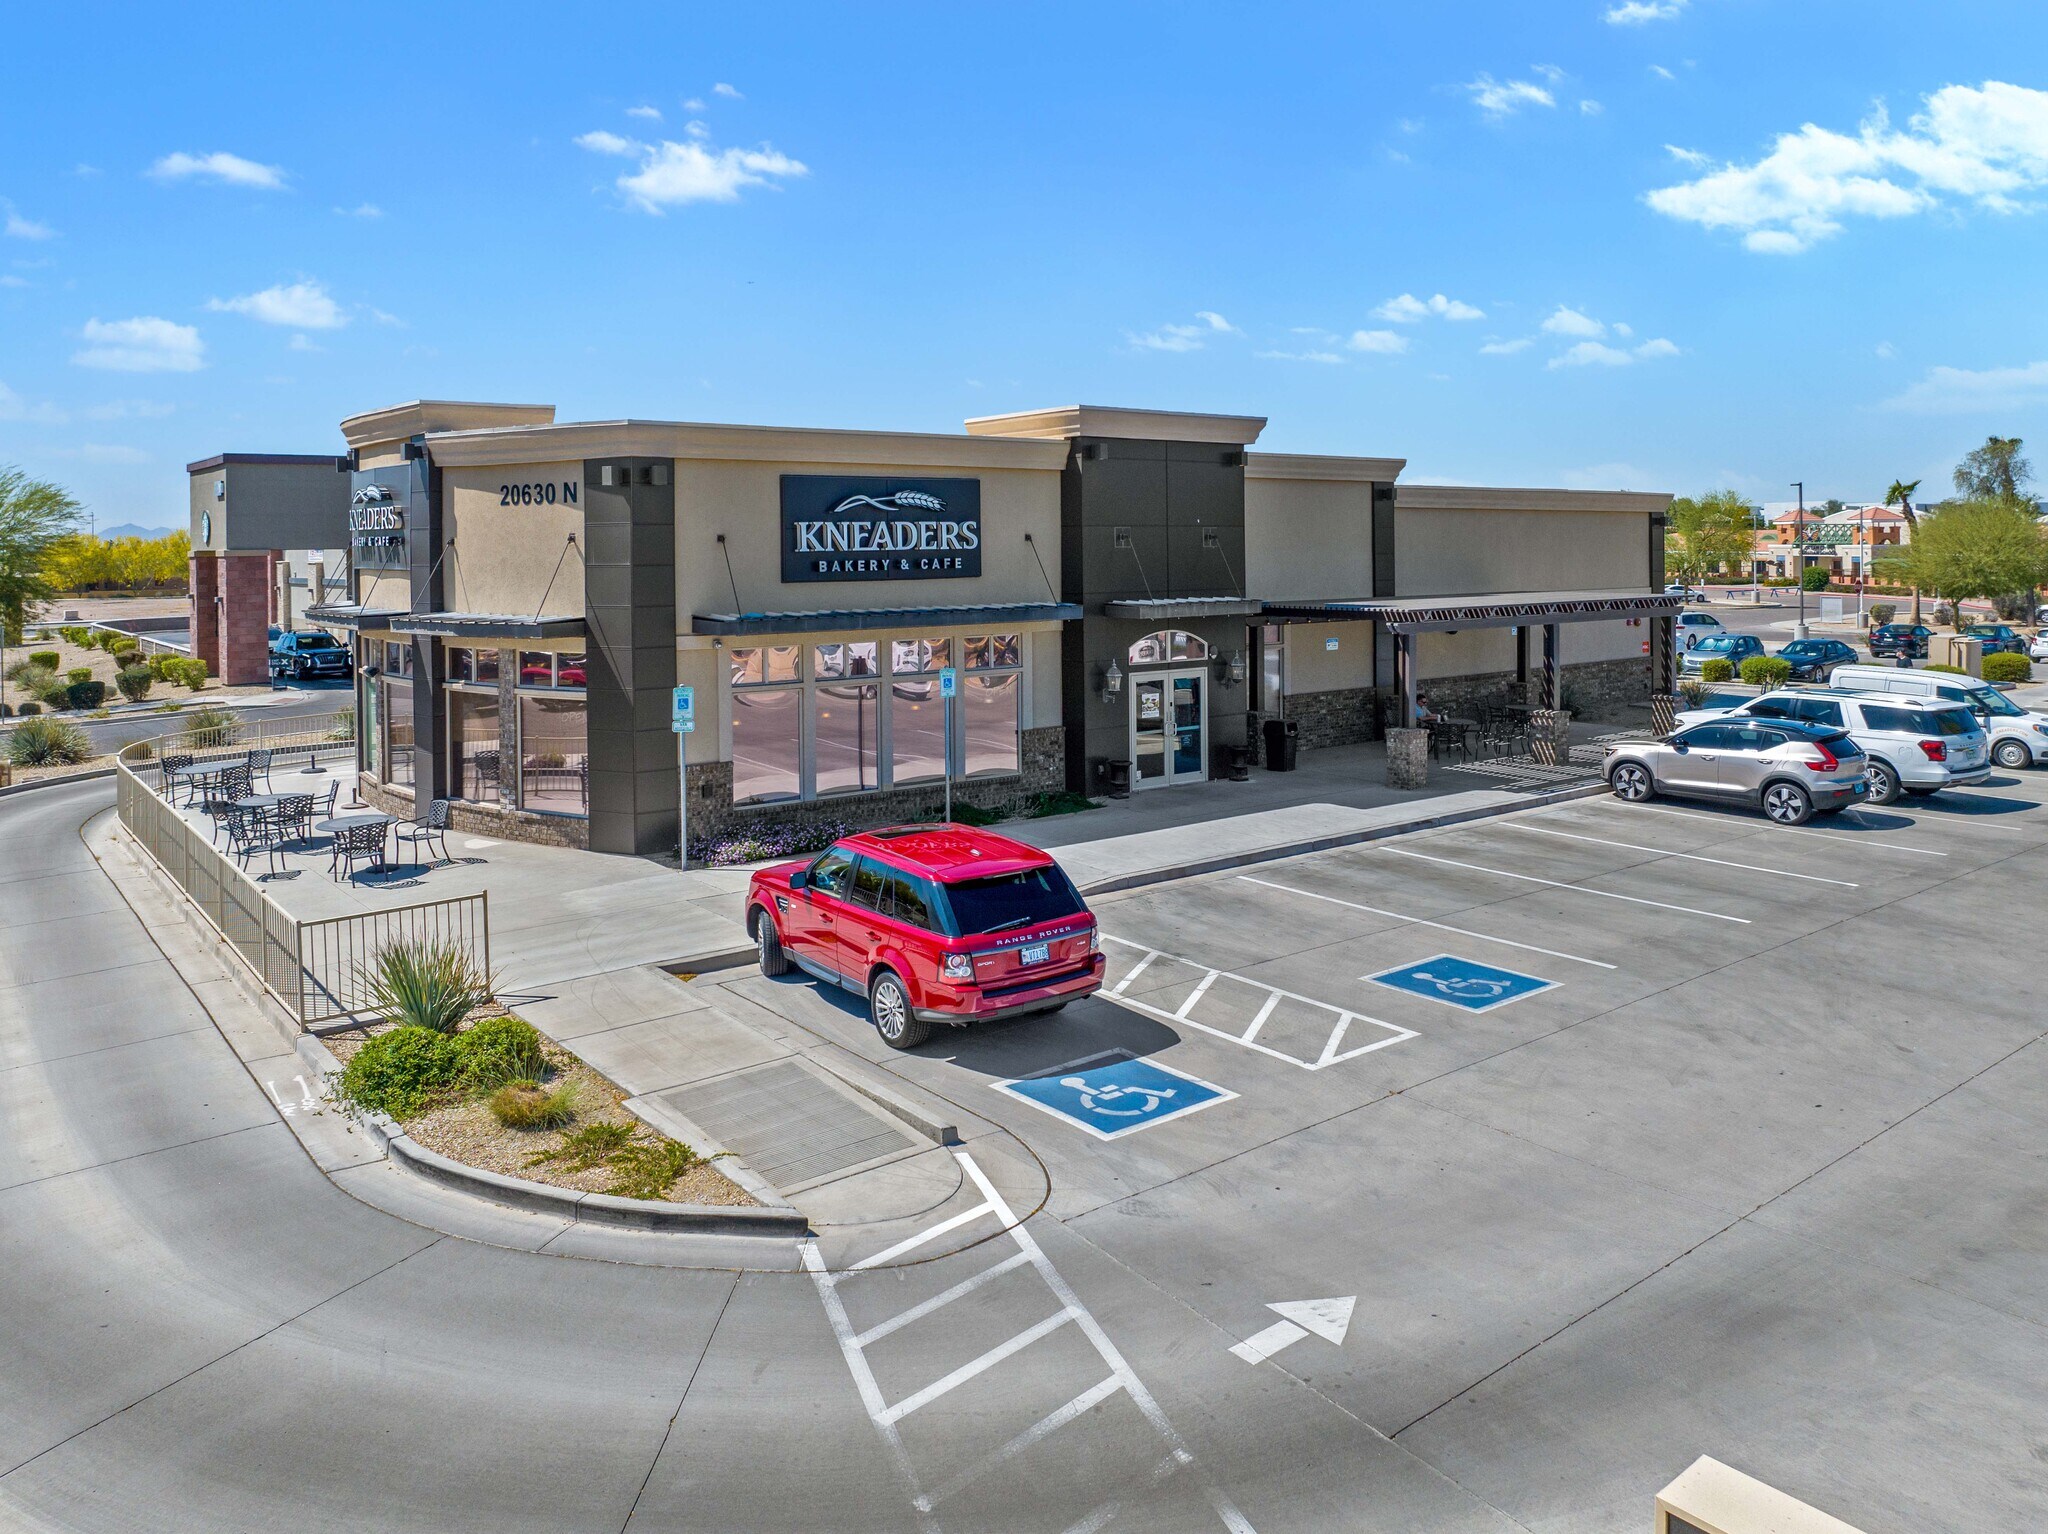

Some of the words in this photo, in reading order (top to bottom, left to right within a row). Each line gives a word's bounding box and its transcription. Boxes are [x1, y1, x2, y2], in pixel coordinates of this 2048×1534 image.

[500, 483, 556, 506] 20630
[563, 482, 578, 503] N
[349, 506, 395, 531] KNEADERS
[374, 536, 390, 546] CAFE
[795, 521, 979, 552] KNEADERS
[819, 559, 890, 573] BAKERY
[900, 559, 910, 570] &
[920, 558, 962, 570] CAFE
[996, 935, 1032, 946] RANGE
[1040, 926, 1071, 938] ROVER
